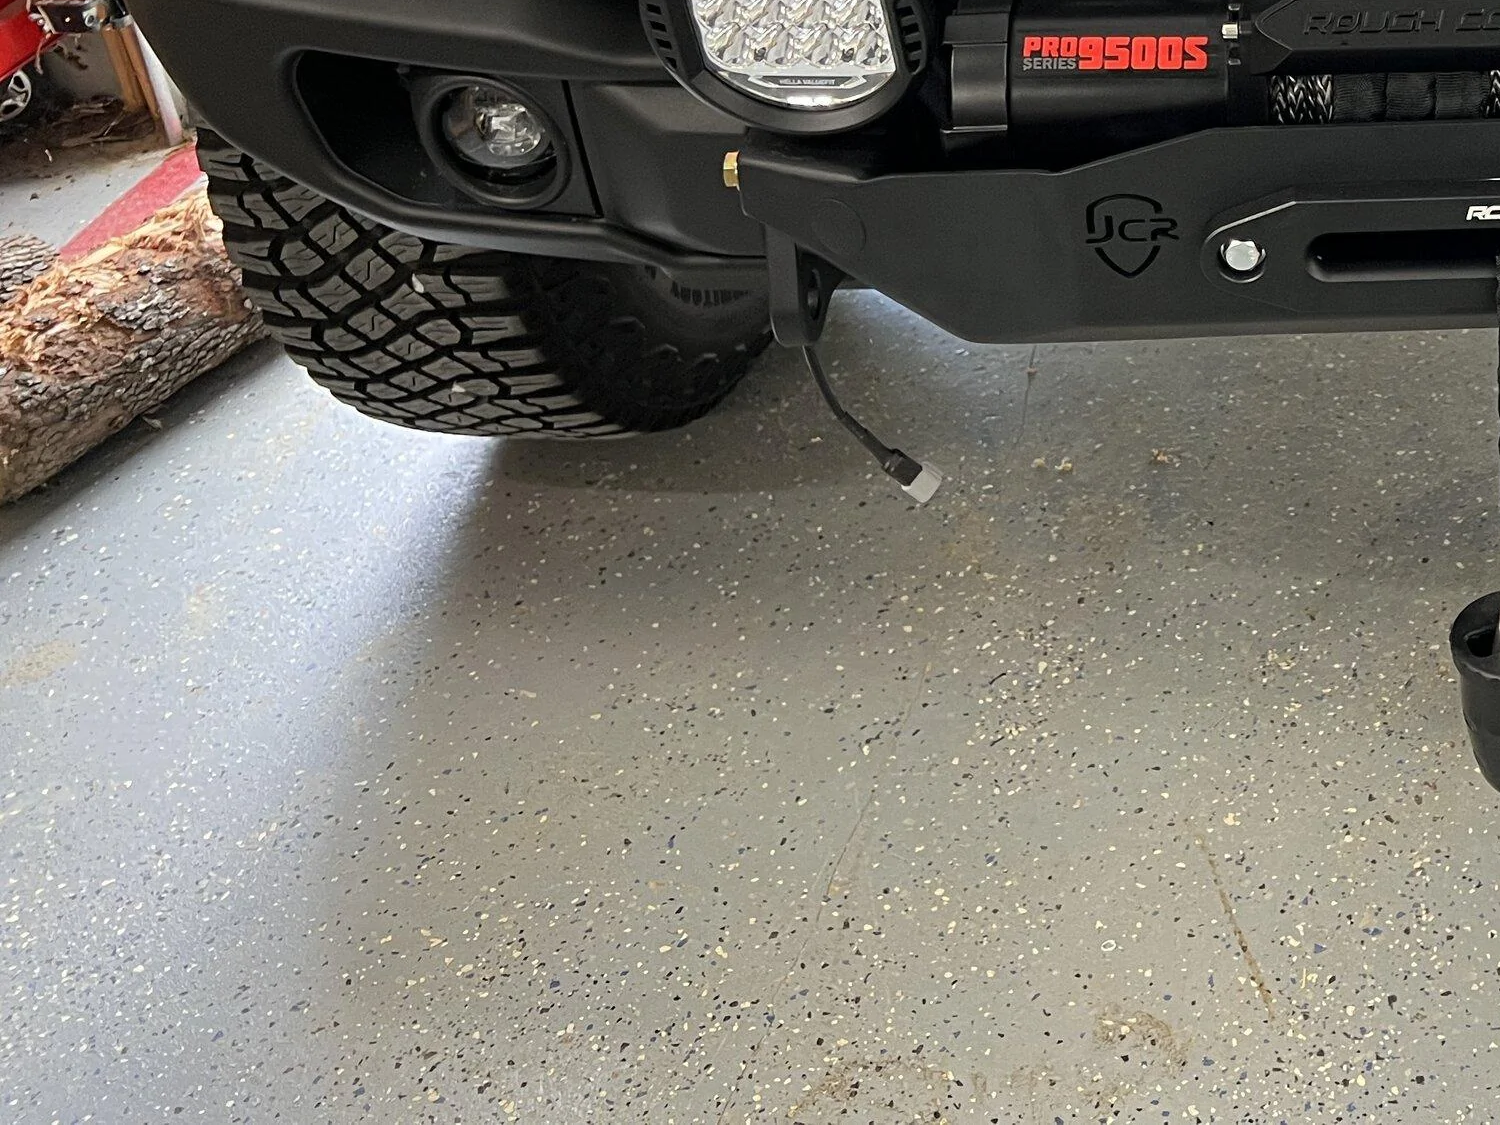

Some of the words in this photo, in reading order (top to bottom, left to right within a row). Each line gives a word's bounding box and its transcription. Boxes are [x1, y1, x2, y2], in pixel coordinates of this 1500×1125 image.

[1304, 9, 1446, 35] ROUGH
[1023, 36, 1078, 57] PRO
[1078, 36, 1208, 70] 9500S
[1023, 57, 1077, 71] SERIES
[1085, 215, 1180, 244] JCR
